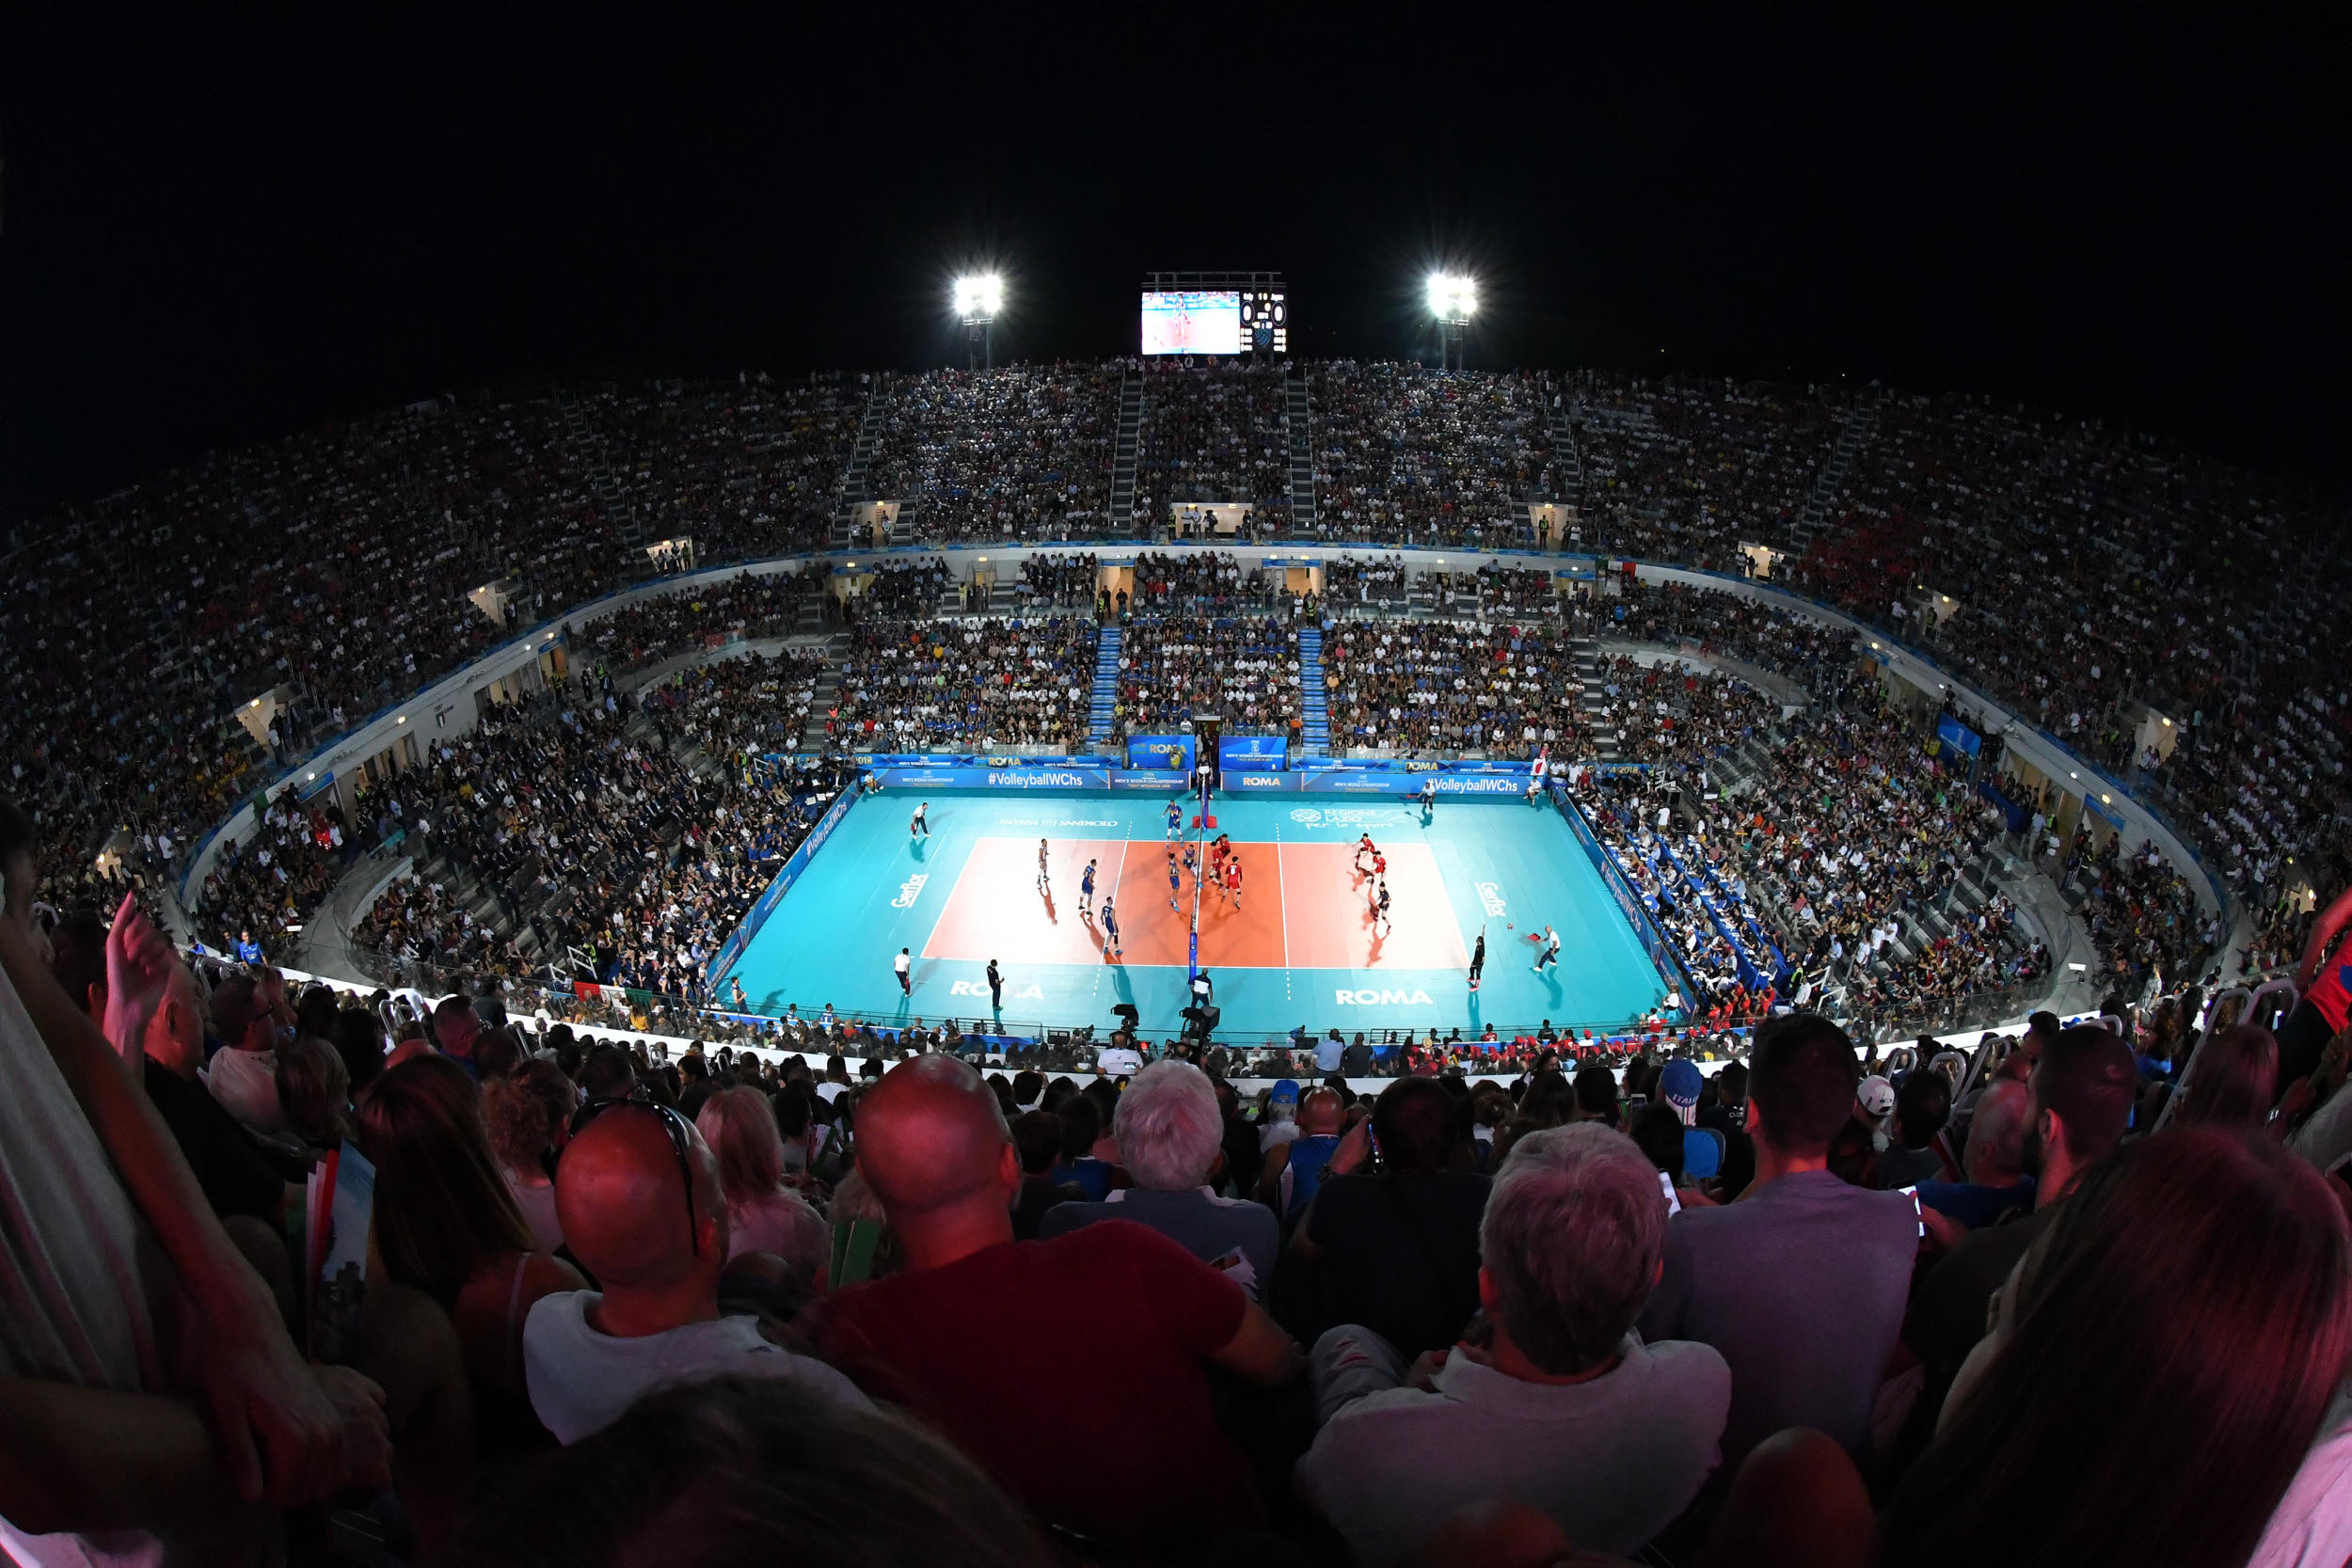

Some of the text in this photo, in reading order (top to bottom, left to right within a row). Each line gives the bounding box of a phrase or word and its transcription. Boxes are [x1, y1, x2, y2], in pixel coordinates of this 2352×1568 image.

[856, 756, 873, 765] 018
[989, 772, 1083, 788] #VolleyballWChs
[1243, 777, 1280, 786] ROMA
[949, 980, 1045, 1000] ROA
[1335, 989, 1435, 1006] ROMA
